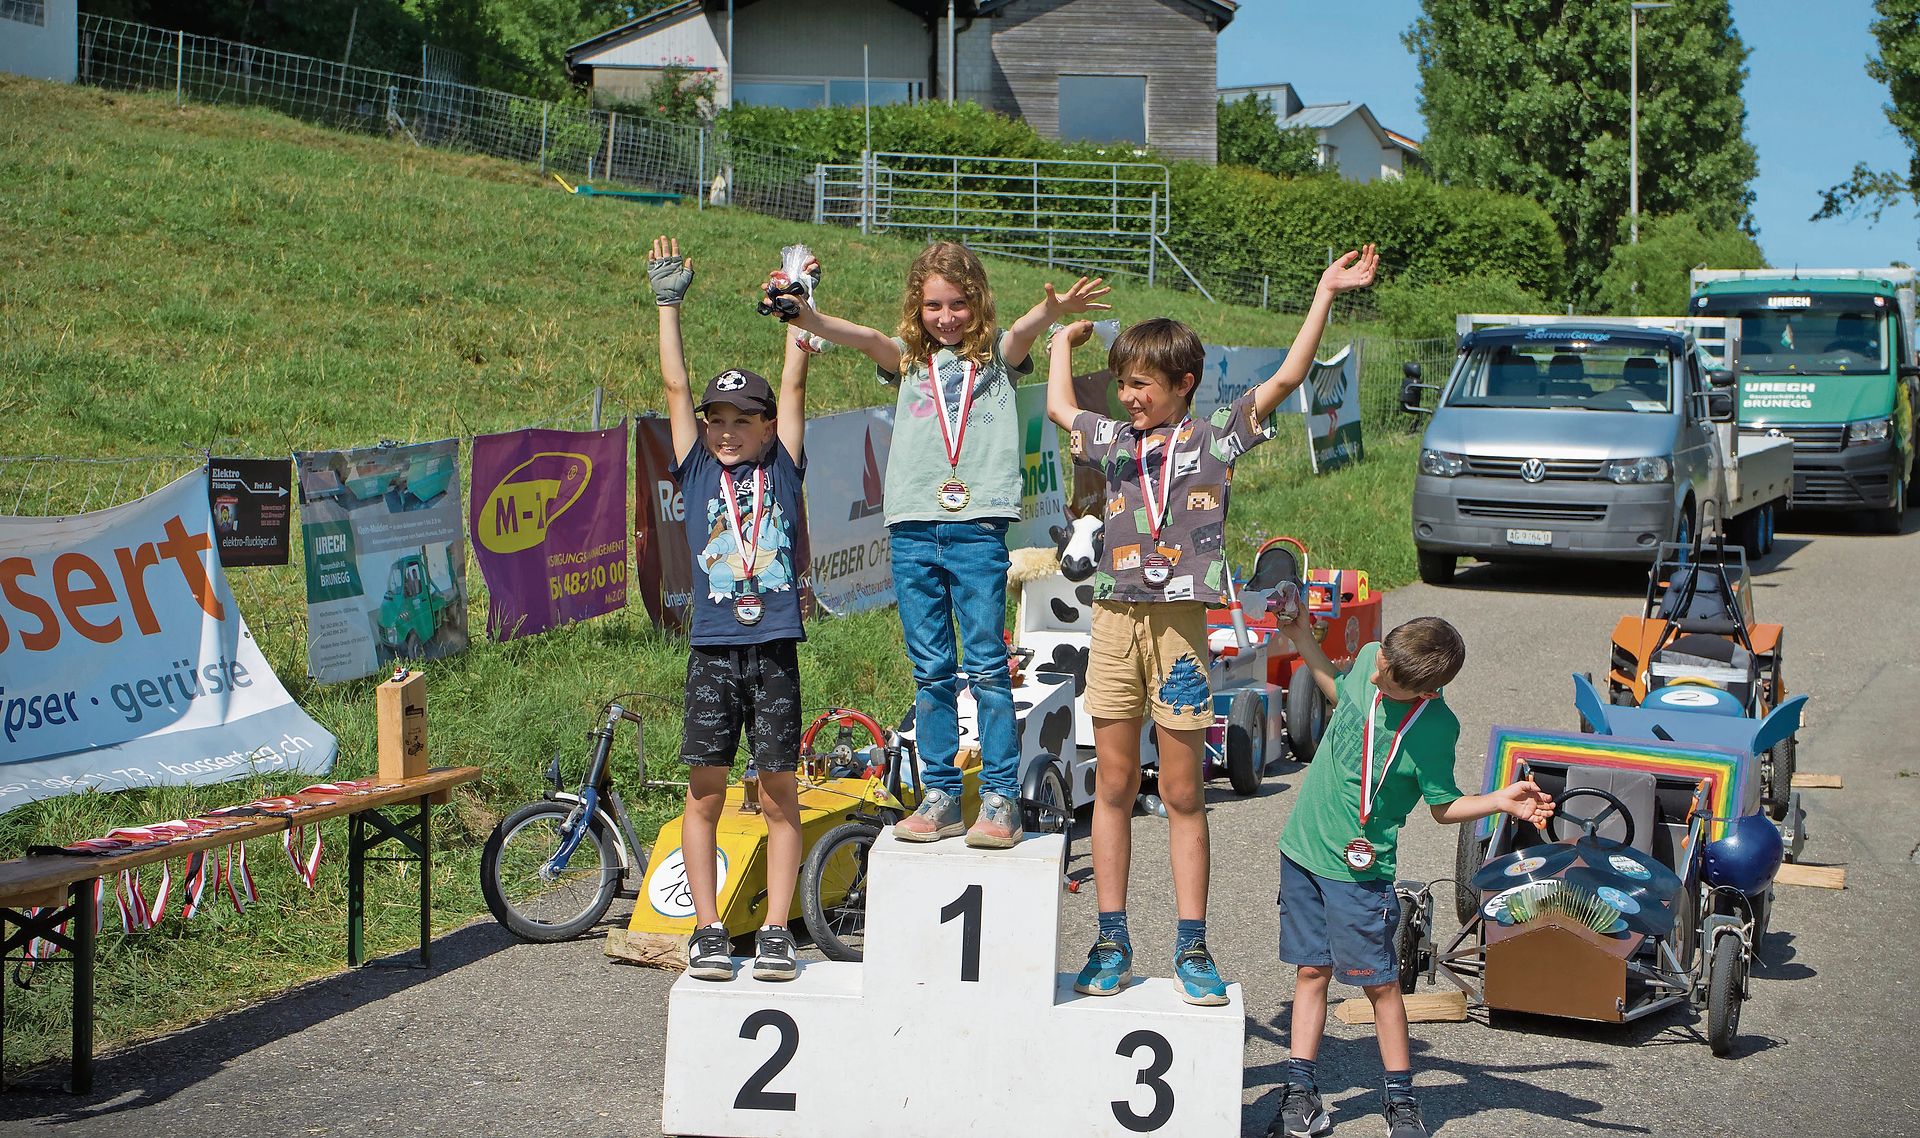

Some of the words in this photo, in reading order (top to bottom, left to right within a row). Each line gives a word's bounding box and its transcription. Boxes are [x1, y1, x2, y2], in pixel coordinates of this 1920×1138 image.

[1768, 297, 1811, 307] URECH
[1525, 329, 1610, 342] SternenGarage
[1744, 383, 1815, 393] URECH
[1743, 399, 1812, 408] BRUNEGG
[212, 468, 240, 479] Elektro
[254, 482, 264, 490] Frei
[265, 482, 273, 490] AG
[658, 480, 686, 522] Re
[1024, 497, 1060, 520] ENGRÜN
[315, 534, 346, 555] URECH
[609, 560, 625, 585] 00
[815, 544, 865, 584] WEBER
[0, 515, 225, 655] sert
[320, 571, 351, 587] BRUNEGG
[111, 655, 253, 723] gerüste
[1673, 692, 1700, 702] 2
[158, 734, 314, 777] bossertag.ch
[660, 880, 693, 907] 18
[940, 884, 983, 982] 1
[733, 1009, 799, 1111] 2
[1111, 1030, 1174, 1132] 3
